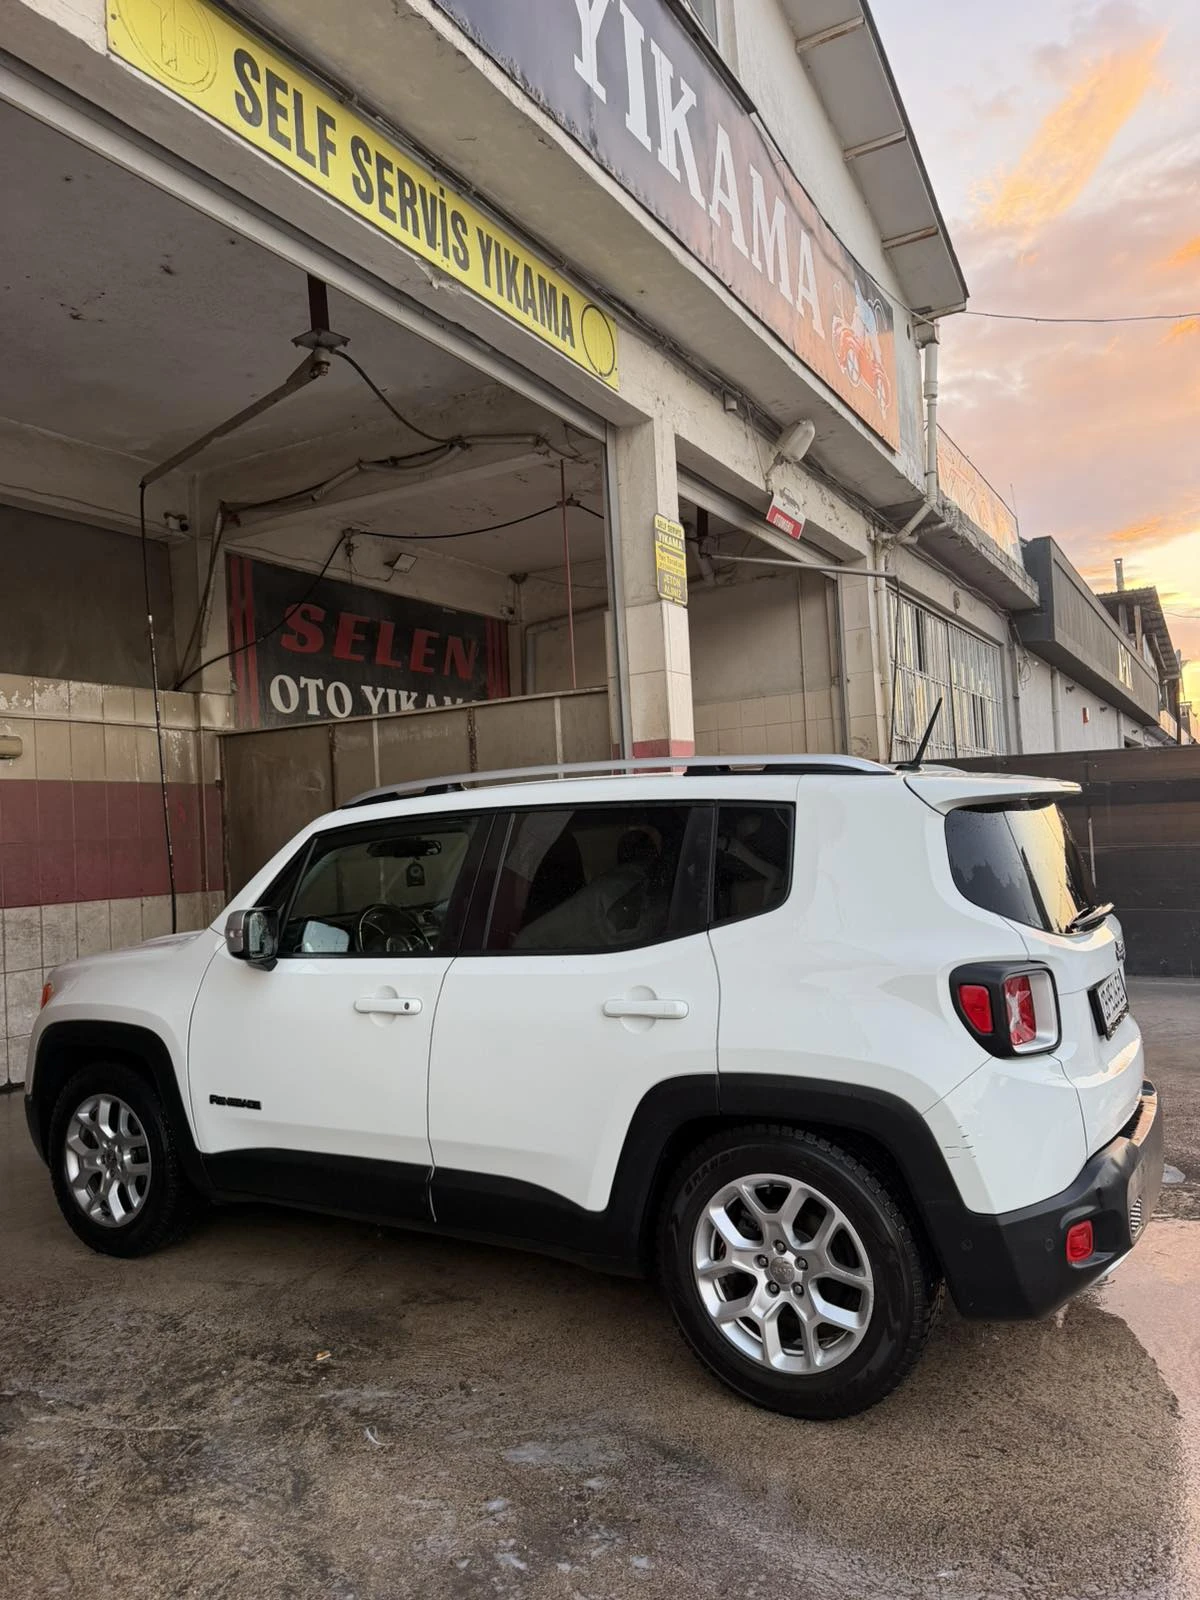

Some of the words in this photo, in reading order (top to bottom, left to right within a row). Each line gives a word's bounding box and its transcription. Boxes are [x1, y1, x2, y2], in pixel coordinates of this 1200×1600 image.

[233, 48, 337, 177] SELF
[350, 134, 470, 273] SERVİS
[476, 226, 576, 349] YIKAMA
[572, 0, 826, 340] YIKAMA
[269, 674, 353, 718] OTO
[280, 602, 479, 681] SELEN
